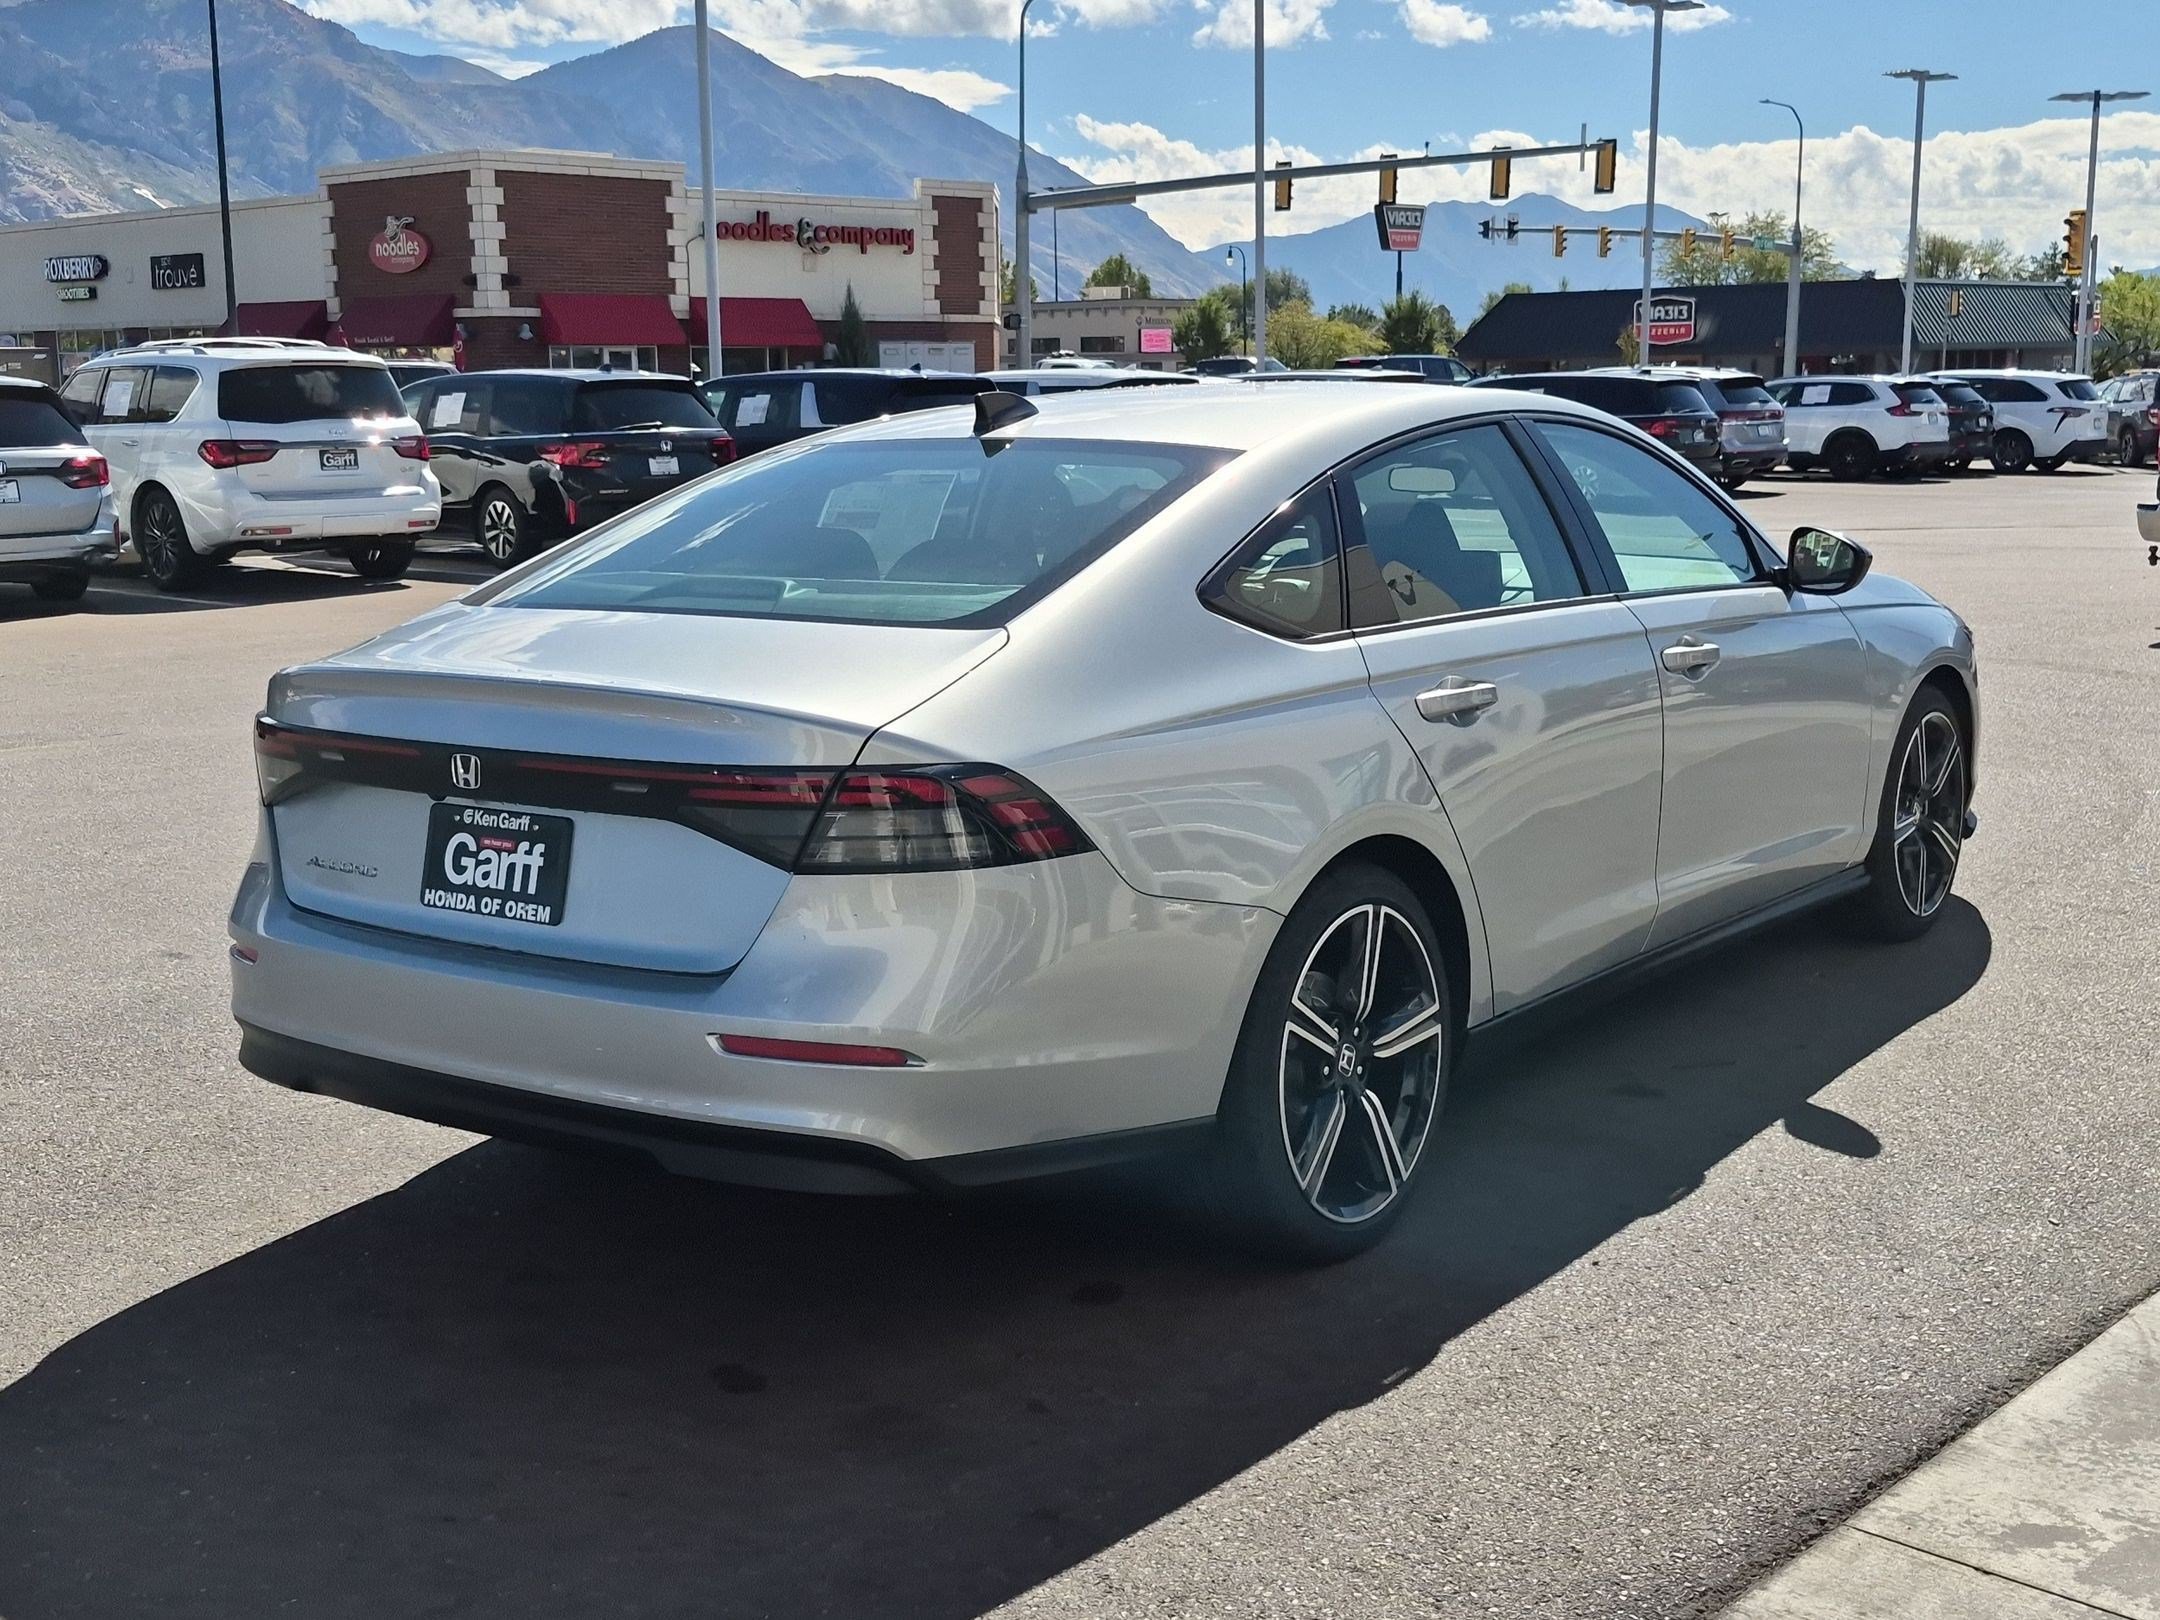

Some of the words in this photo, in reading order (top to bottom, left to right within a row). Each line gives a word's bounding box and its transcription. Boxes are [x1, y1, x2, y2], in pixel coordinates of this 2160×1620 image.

[375, 233, 419, 257] noodles
[716, 210, 795, 242] oodles
[813, 224, 914, 255] company
[44, 256, 95, 281] ROXBERRY
[155, 264, 198, 289] trouvé
[323, 453, 355, 466] Garff
[473, 810, 498, 828] Ken
[499, 812, 531, 832] Garff
[444, 832, 546, 895] Garff
[424, 888, 476, 912] HONDA
[480, 896, 502, 915] OF
[504, 900, 551, 924] OREM
